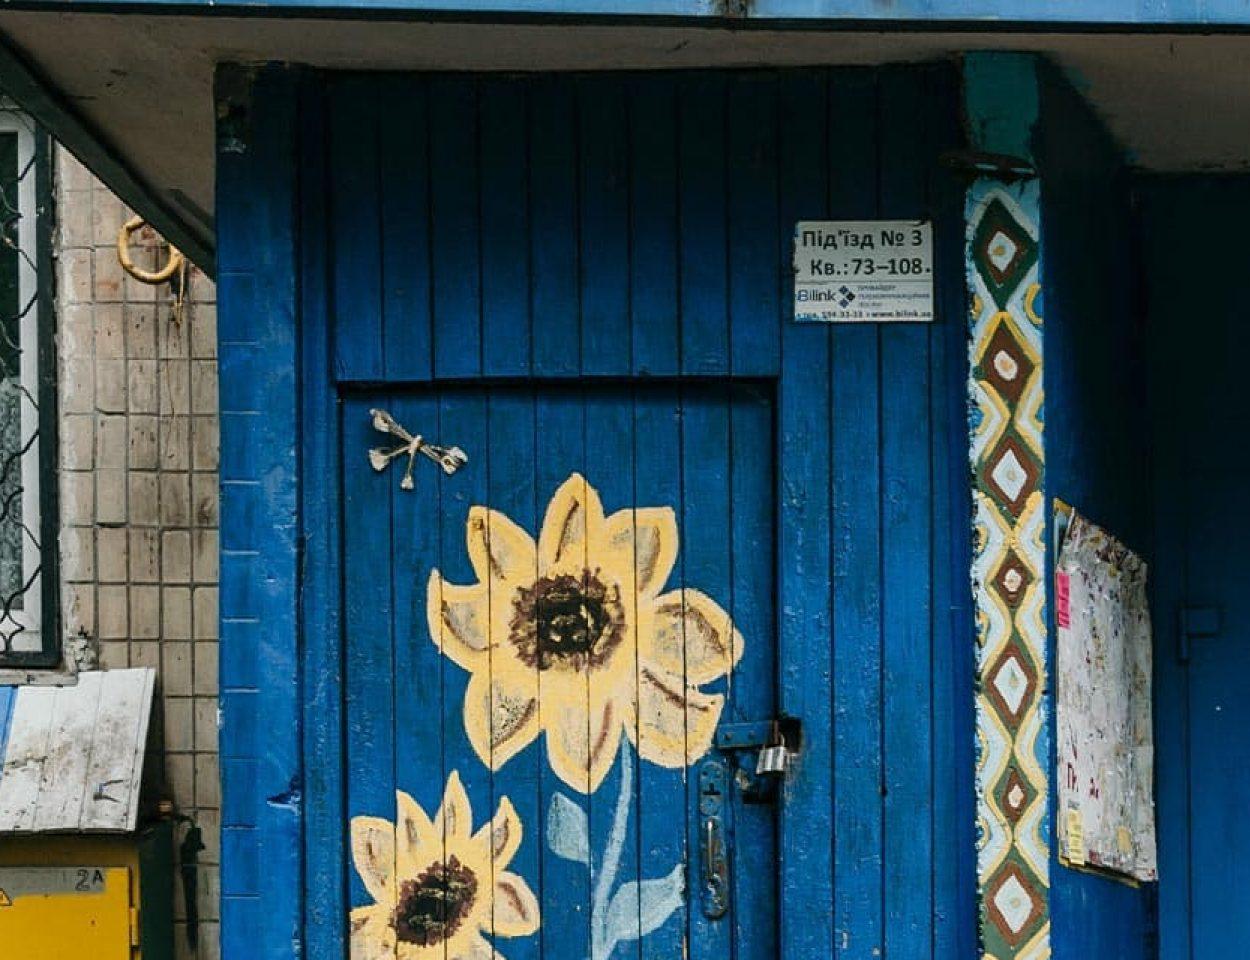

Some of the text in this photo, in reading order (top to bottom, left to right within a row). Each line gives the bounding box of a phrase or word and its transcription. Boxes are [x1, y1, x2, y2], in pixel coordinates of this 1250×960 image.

[802, 230, 923, 250] Під'їзд № 3
[797, 289, 836, 301] Bilink
